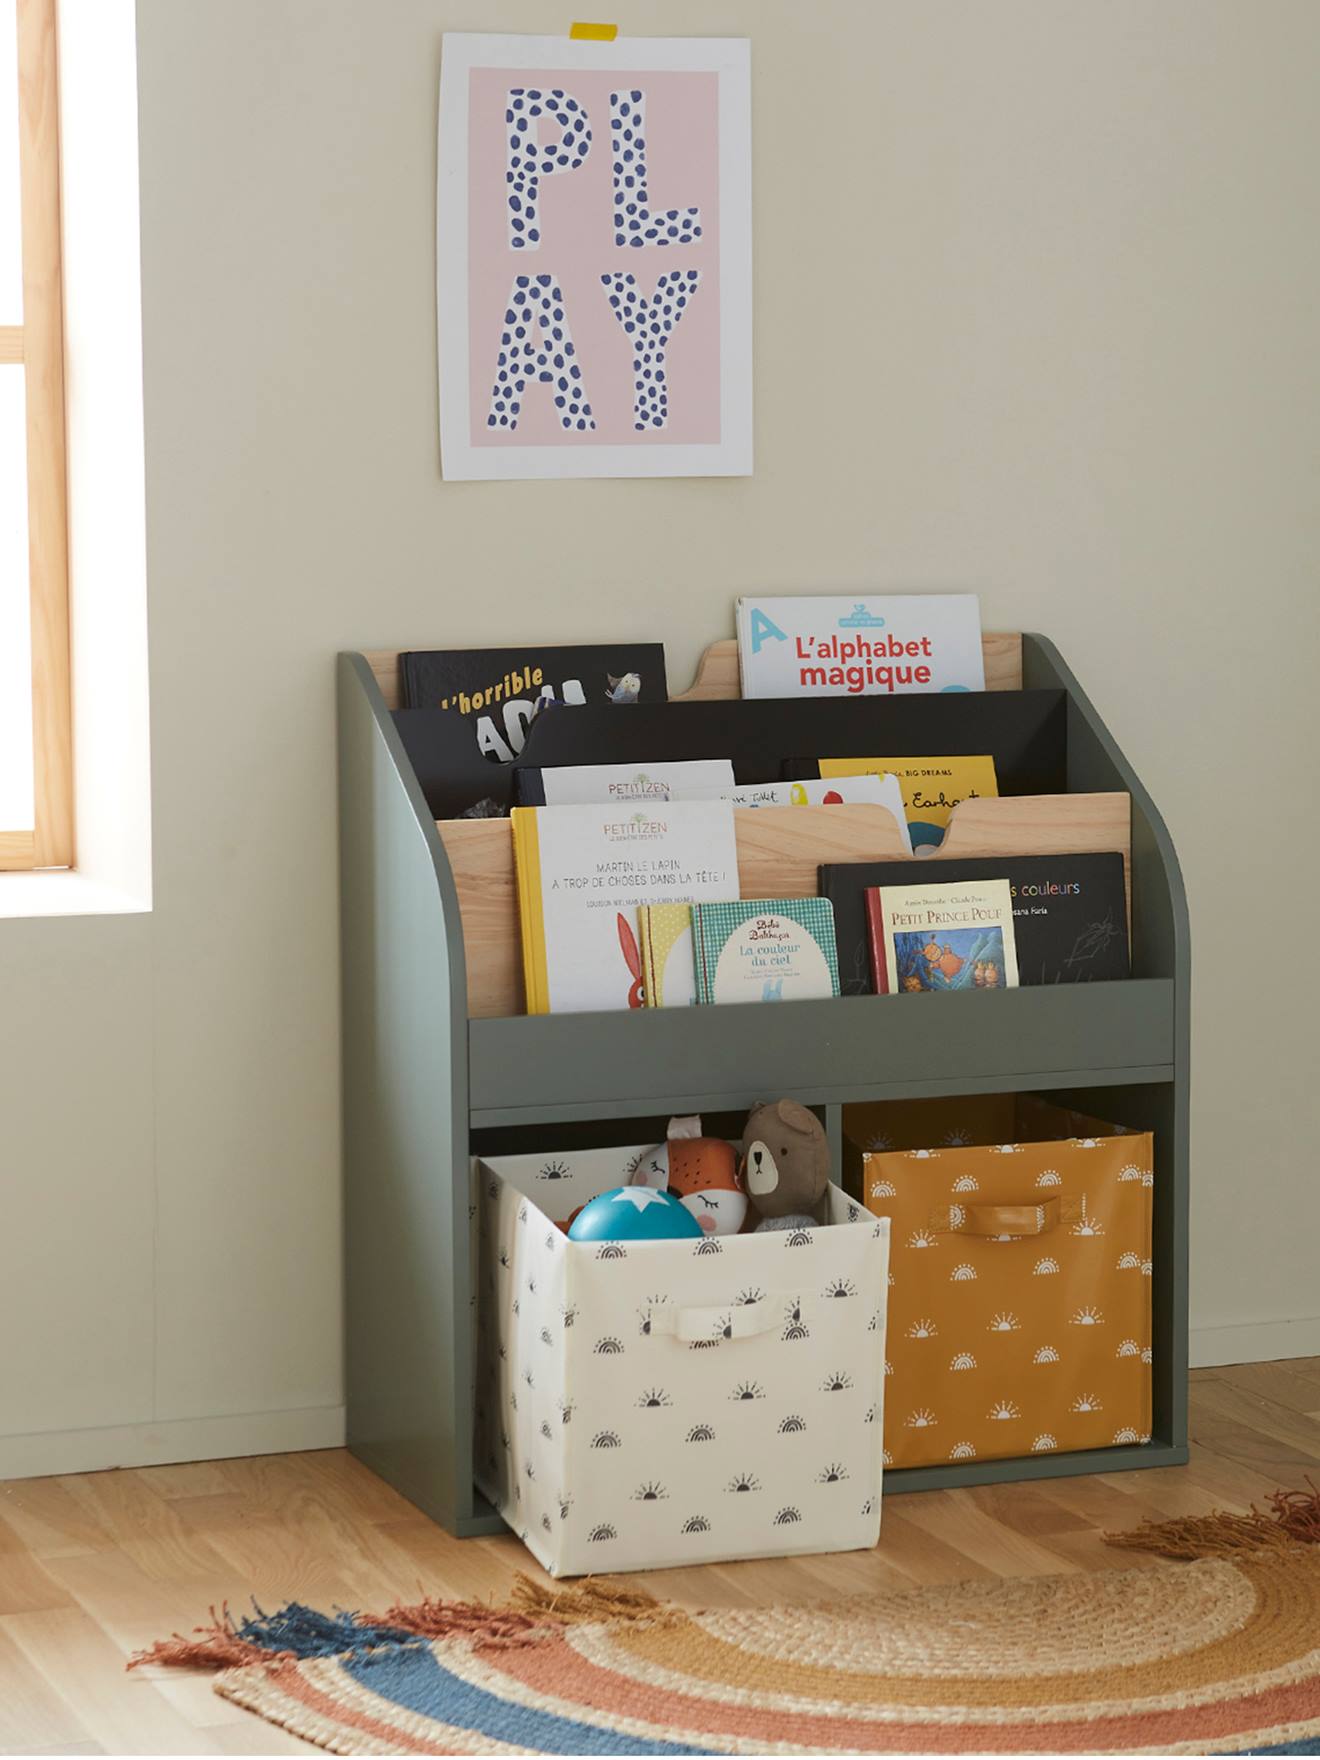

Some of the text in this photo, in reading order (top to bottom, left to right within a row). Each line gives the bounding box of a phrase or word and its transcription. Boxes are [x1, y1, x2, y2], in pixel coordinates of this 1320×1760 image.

[795, 634, 932, 664] L'alphabet
[800, 660, 932, 693] magique
[905, 769, 919, 777] BIG
[596, 862, 634, 873] MARTIN
[652, 859, 680, 871] LAPIN
[563, 877, 588, 889] TROP
[592, 876, 604, 888] DE
[607, 874, 647, 887] CHOSES
[650, 873, 676, 885] DANS
[679, 872, 692, 884] LA
[696, 869, 719, 883] TÊTE
[1021, 882, 1080, 896] couleurs
[891, 911, 923, 926] PETIT
[927, 910, 969, 924] PRINCE
[740, 943, 801, 956] La couleur
[751, 955, 790, 967] du ciel
